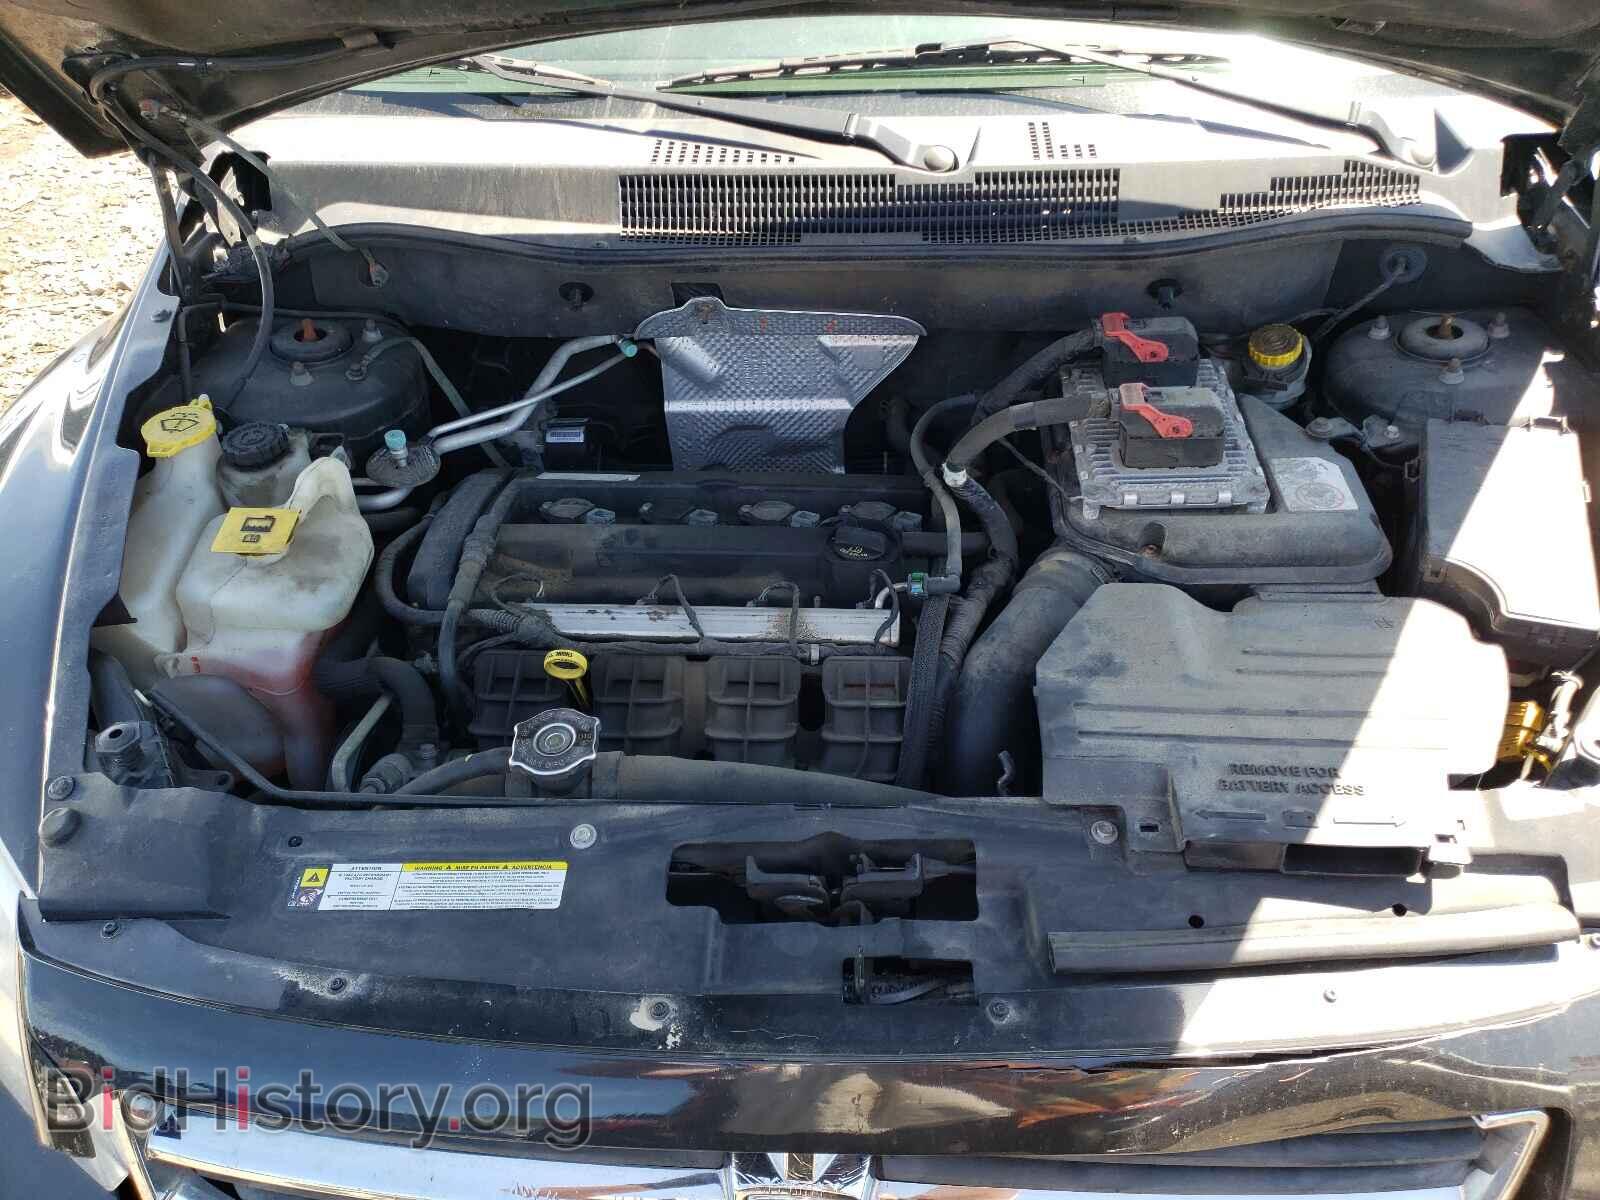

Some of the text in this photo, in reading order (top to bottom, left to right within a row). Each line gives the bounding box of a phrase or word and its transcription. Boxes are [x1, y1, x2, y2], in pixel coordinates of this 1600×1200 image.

[1229, 763, 1340, 778] REMOVE FOR
[1218, 779, 1366, 795] BATTERY ACCESS
